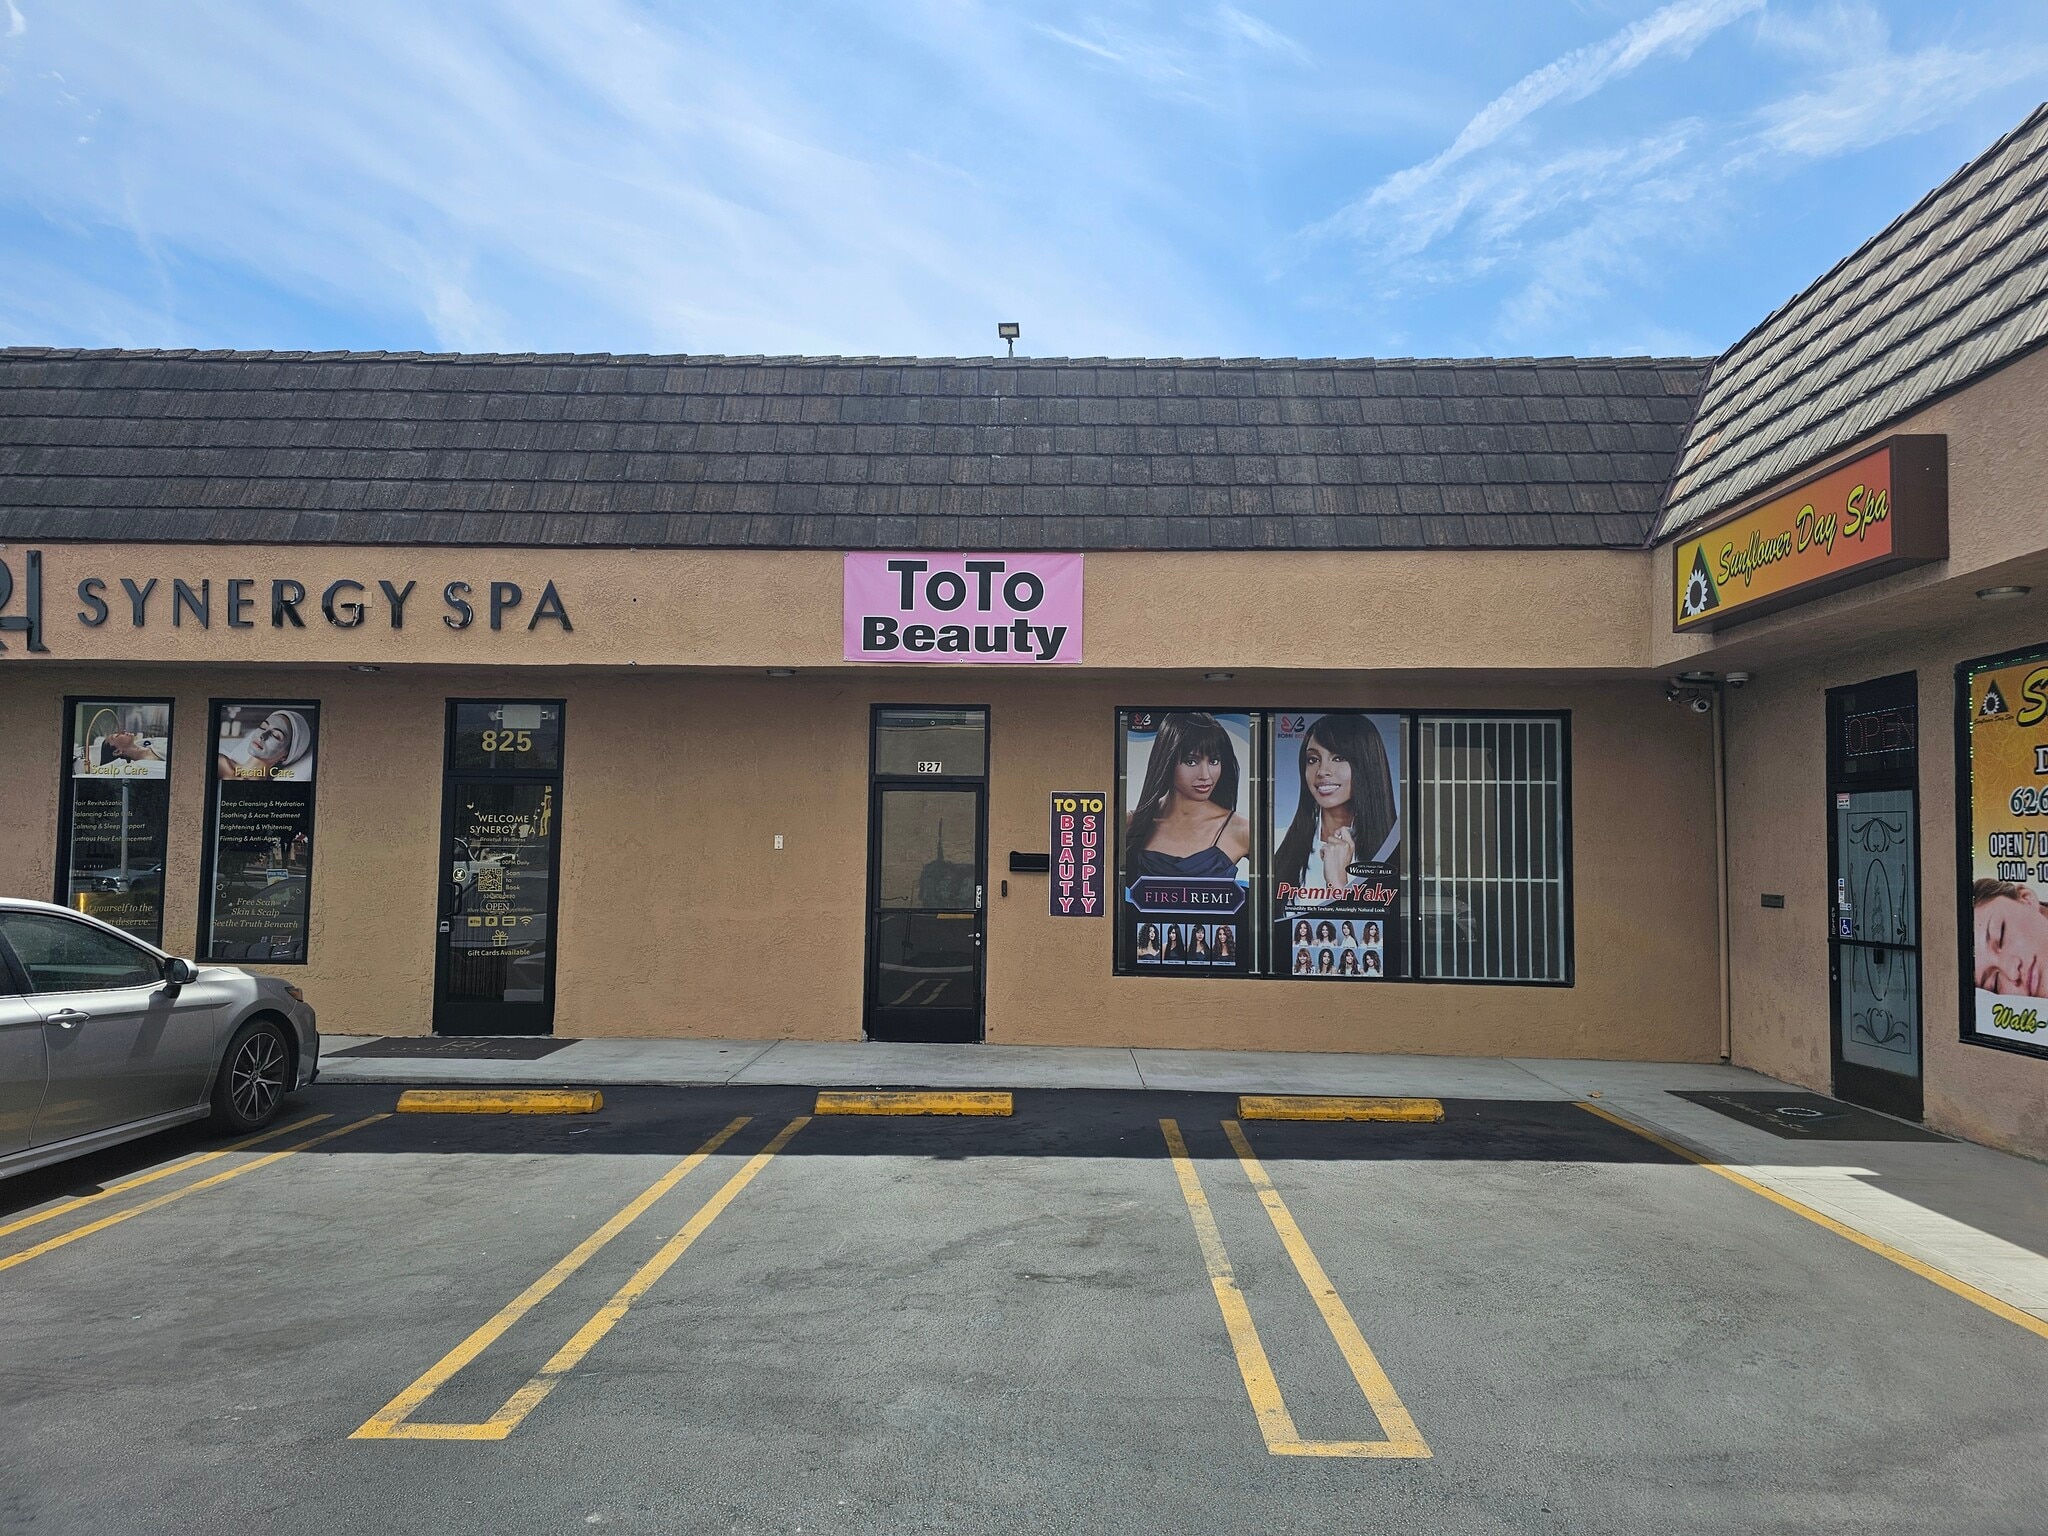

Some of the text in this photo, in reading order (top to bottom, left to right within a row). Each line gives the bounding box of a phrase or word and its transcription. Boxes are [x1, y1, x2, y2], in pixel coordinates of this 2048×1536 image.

[1716, 484, 1890, 588] Sunflower Day Spa
[887, 559, 1045, 612] ToTo
[77, 577, 417, 630] SYNERGY
[443, 579, 573, 631] SPA
[862, 615, 1068, 662] Beauty
[1847, 712, 1914, 752] OPEN
[481, 730, 532, 752] 825
[91, 764, 149, 778] Scalp Care
[234, 766, 295, 778] Facial Care
[918, 762, 942, 773] 827
[1054, 798, 1103, 813] TO TO
[103, 811, 120, 819] Scalp
[220, 812, 247, 820] Soothing
[478, 814, 529, 823] WELCOME
[104, 823, 120, 831] Sleep
[220, 824, 255, 832] Brightening
[262, 824, 293, 832] Whitening
[469, 825, 536, 834] SYNERGY SA
[1989, 831, 2024, 858] OPEN
[2025, 831, 2037, 858] 7
[1058, 814, 1075, 914] BEAUTY
[1080, 815, 1097, 914] SUPPLY
[1997, 860, 2027, 882] 10AM
[92, 903, 130, 913] yourself
[130, 904, 138, 912] to
[140, 903, 153, 912] the
[236, 898, 276, 906] Free Scan
[485, 902, 510, 911] OPEN
[231, 907, 250, 916] Skin
[256, 908, 280, 918] Scalp
[240, 919, 262, 928] Truth
